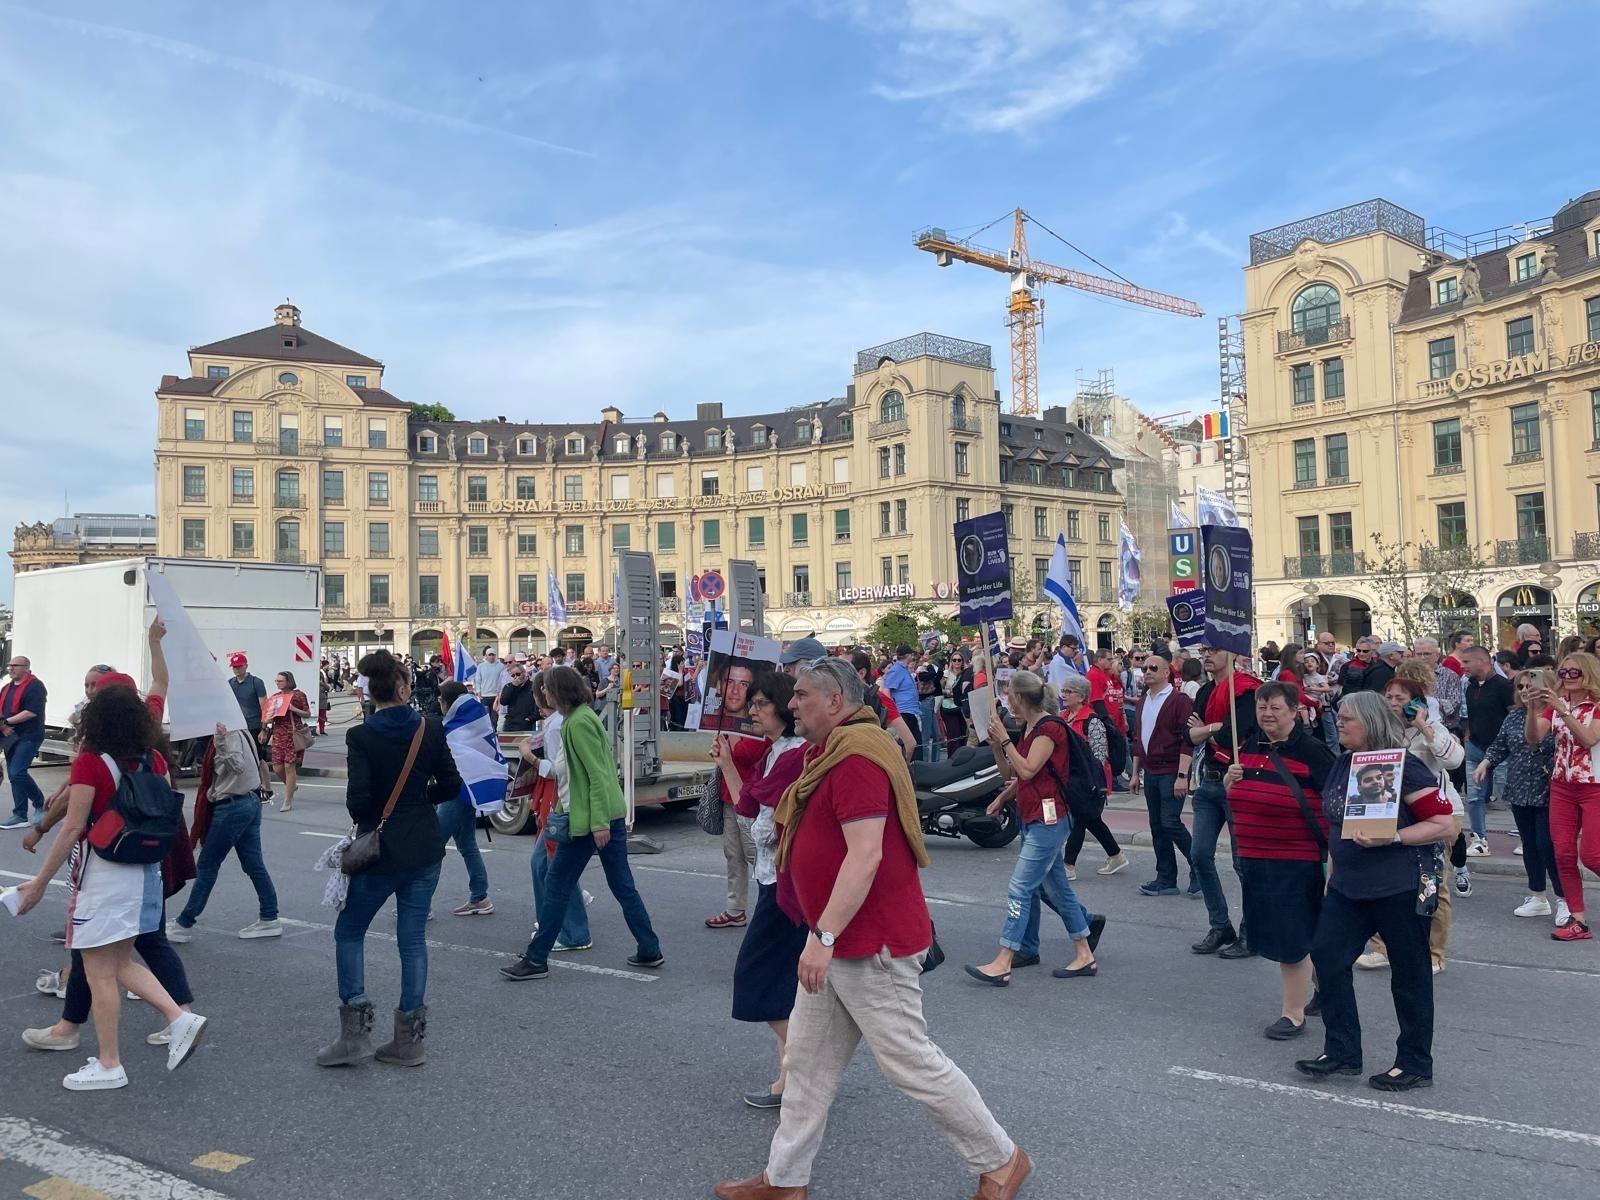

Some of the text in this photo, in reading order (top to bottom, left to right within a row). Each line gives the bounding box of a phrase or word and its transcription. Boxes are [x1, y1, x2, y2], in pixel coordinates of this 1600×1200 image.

[1450, 350, 1549, 393] OSRAM
[489, 499, 552, 513] OSRAM
[773, 483, 826, 501] OSRAM
[1176, 536, 1189, 552] U
[1176, 558, 1191, 577] S
[839, 583, 915, 601] LEDERWAREN
[983, 583, 992, 591] Her
[993, 581, 1003, 589] Life
[1356, 754, 1398, 762] ENTFÜHRT
